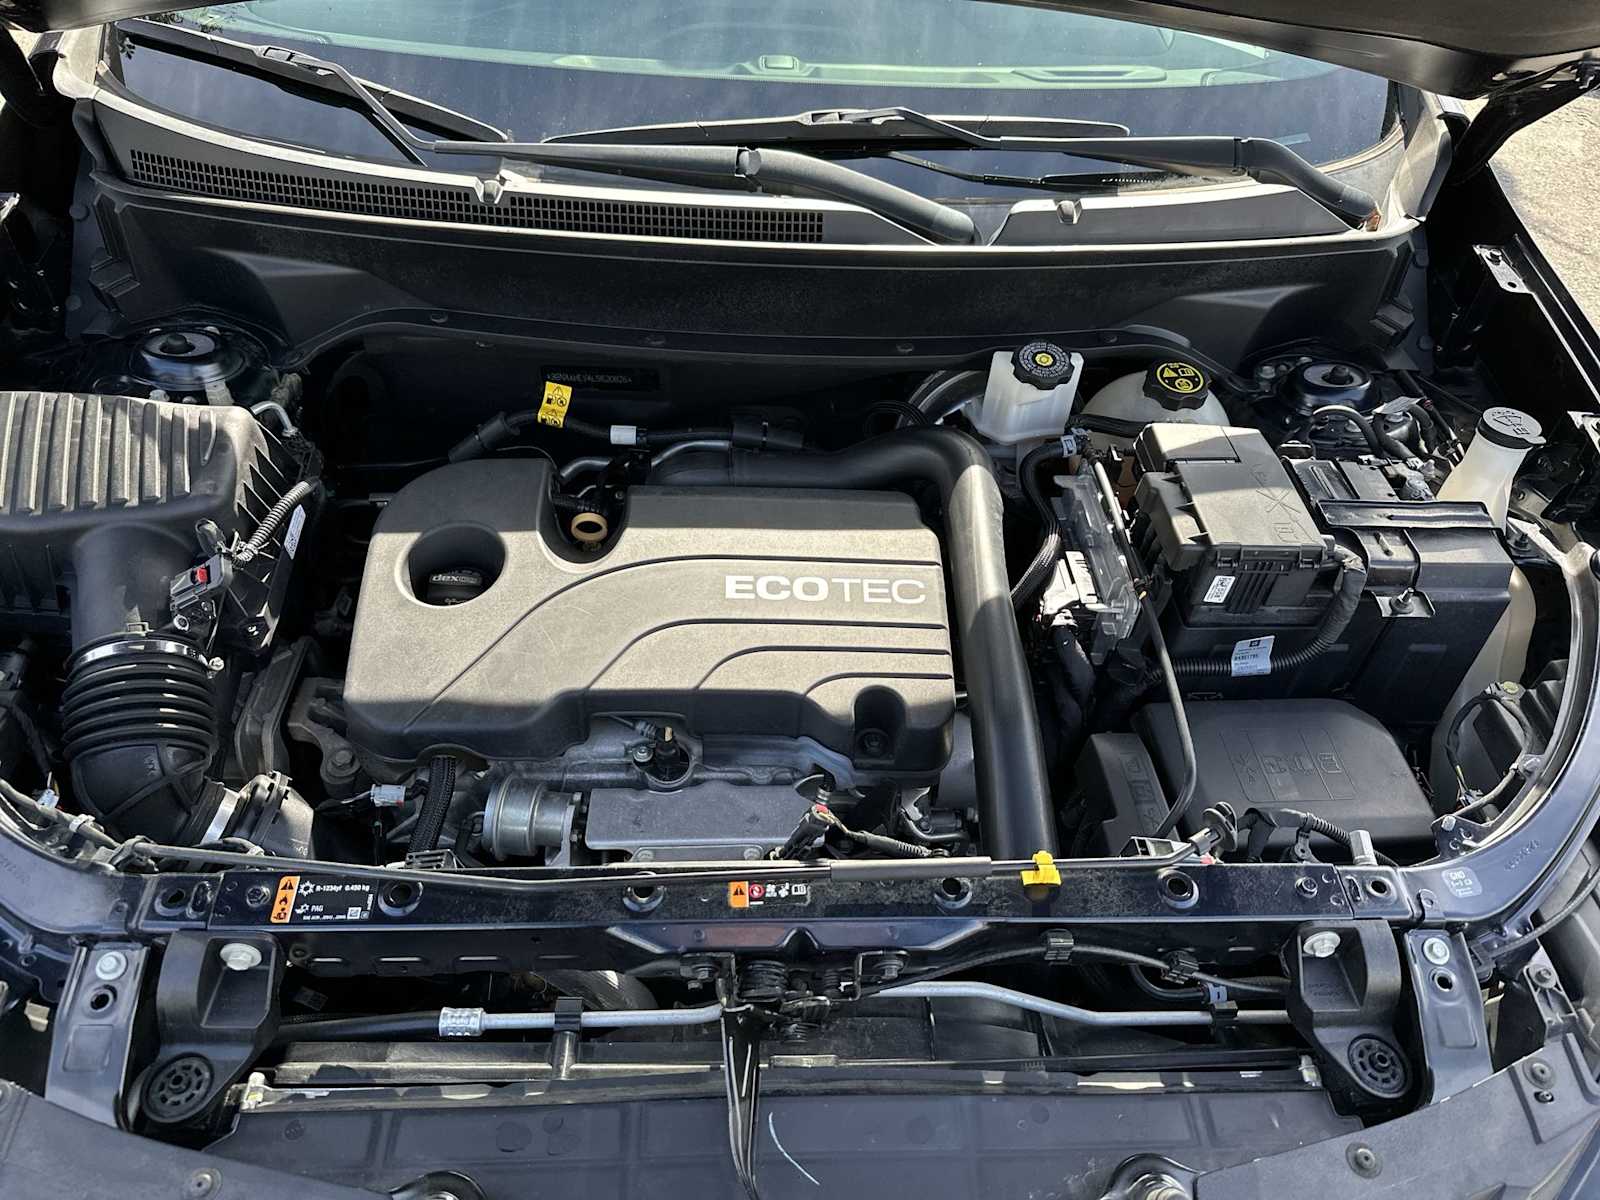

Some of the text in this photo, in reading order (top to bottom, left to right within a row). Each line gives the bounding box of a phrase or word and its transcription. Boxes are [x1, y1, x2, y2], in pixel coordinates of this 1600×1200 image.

[724, 575, 927, 604] ECOTEC
[315, 885, 342, 893] R-1234yf
[361, 884, 370, 892] kg
